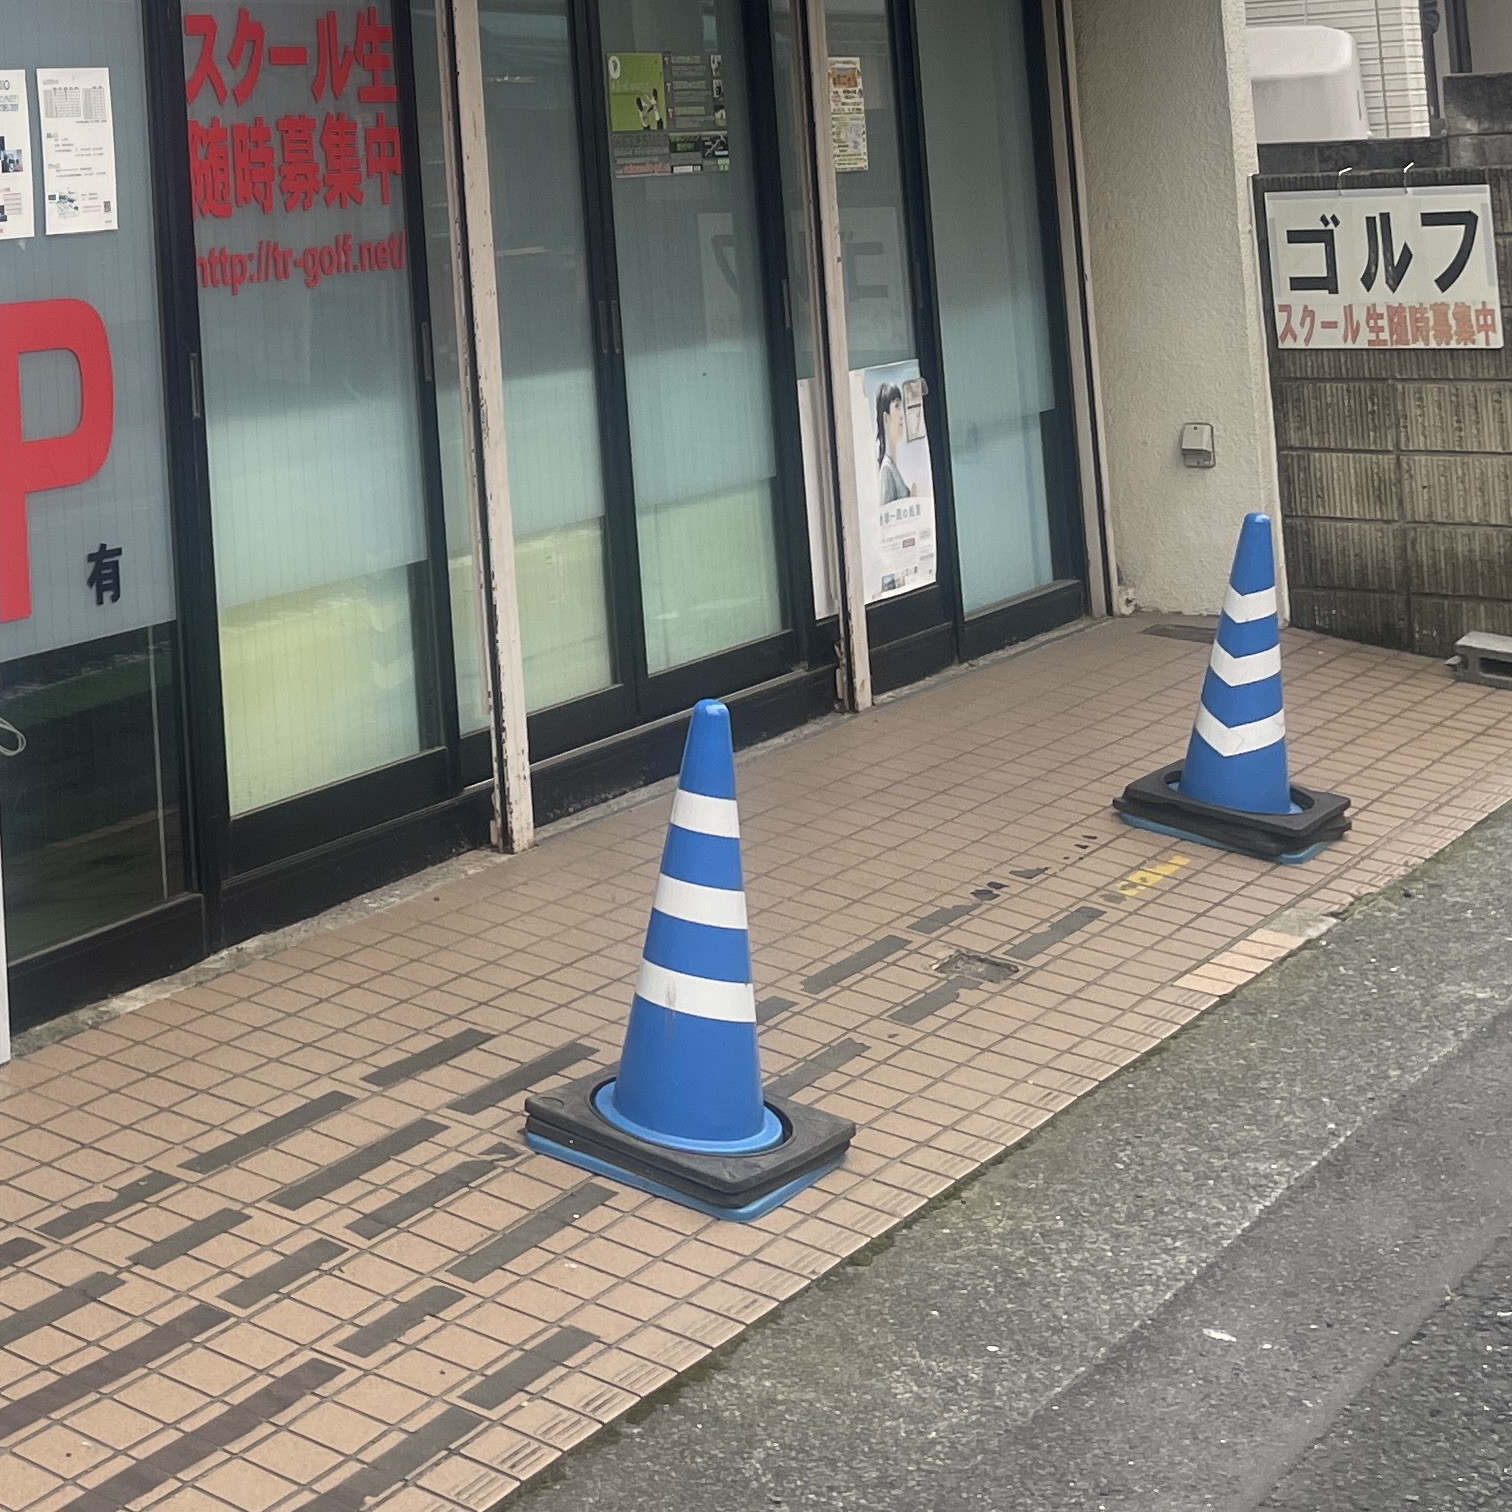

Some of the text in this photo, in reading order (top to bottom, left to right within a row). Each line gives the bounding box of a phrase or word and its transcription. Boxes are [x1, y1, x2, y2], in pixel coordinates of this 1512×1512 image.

[183, 5, 399, 106] スクール生
[187, 111, 403, 221] 随時募集中
[1286, 209, 1479, 295] ゴルフ
[86, 543, 123, 606] 有
